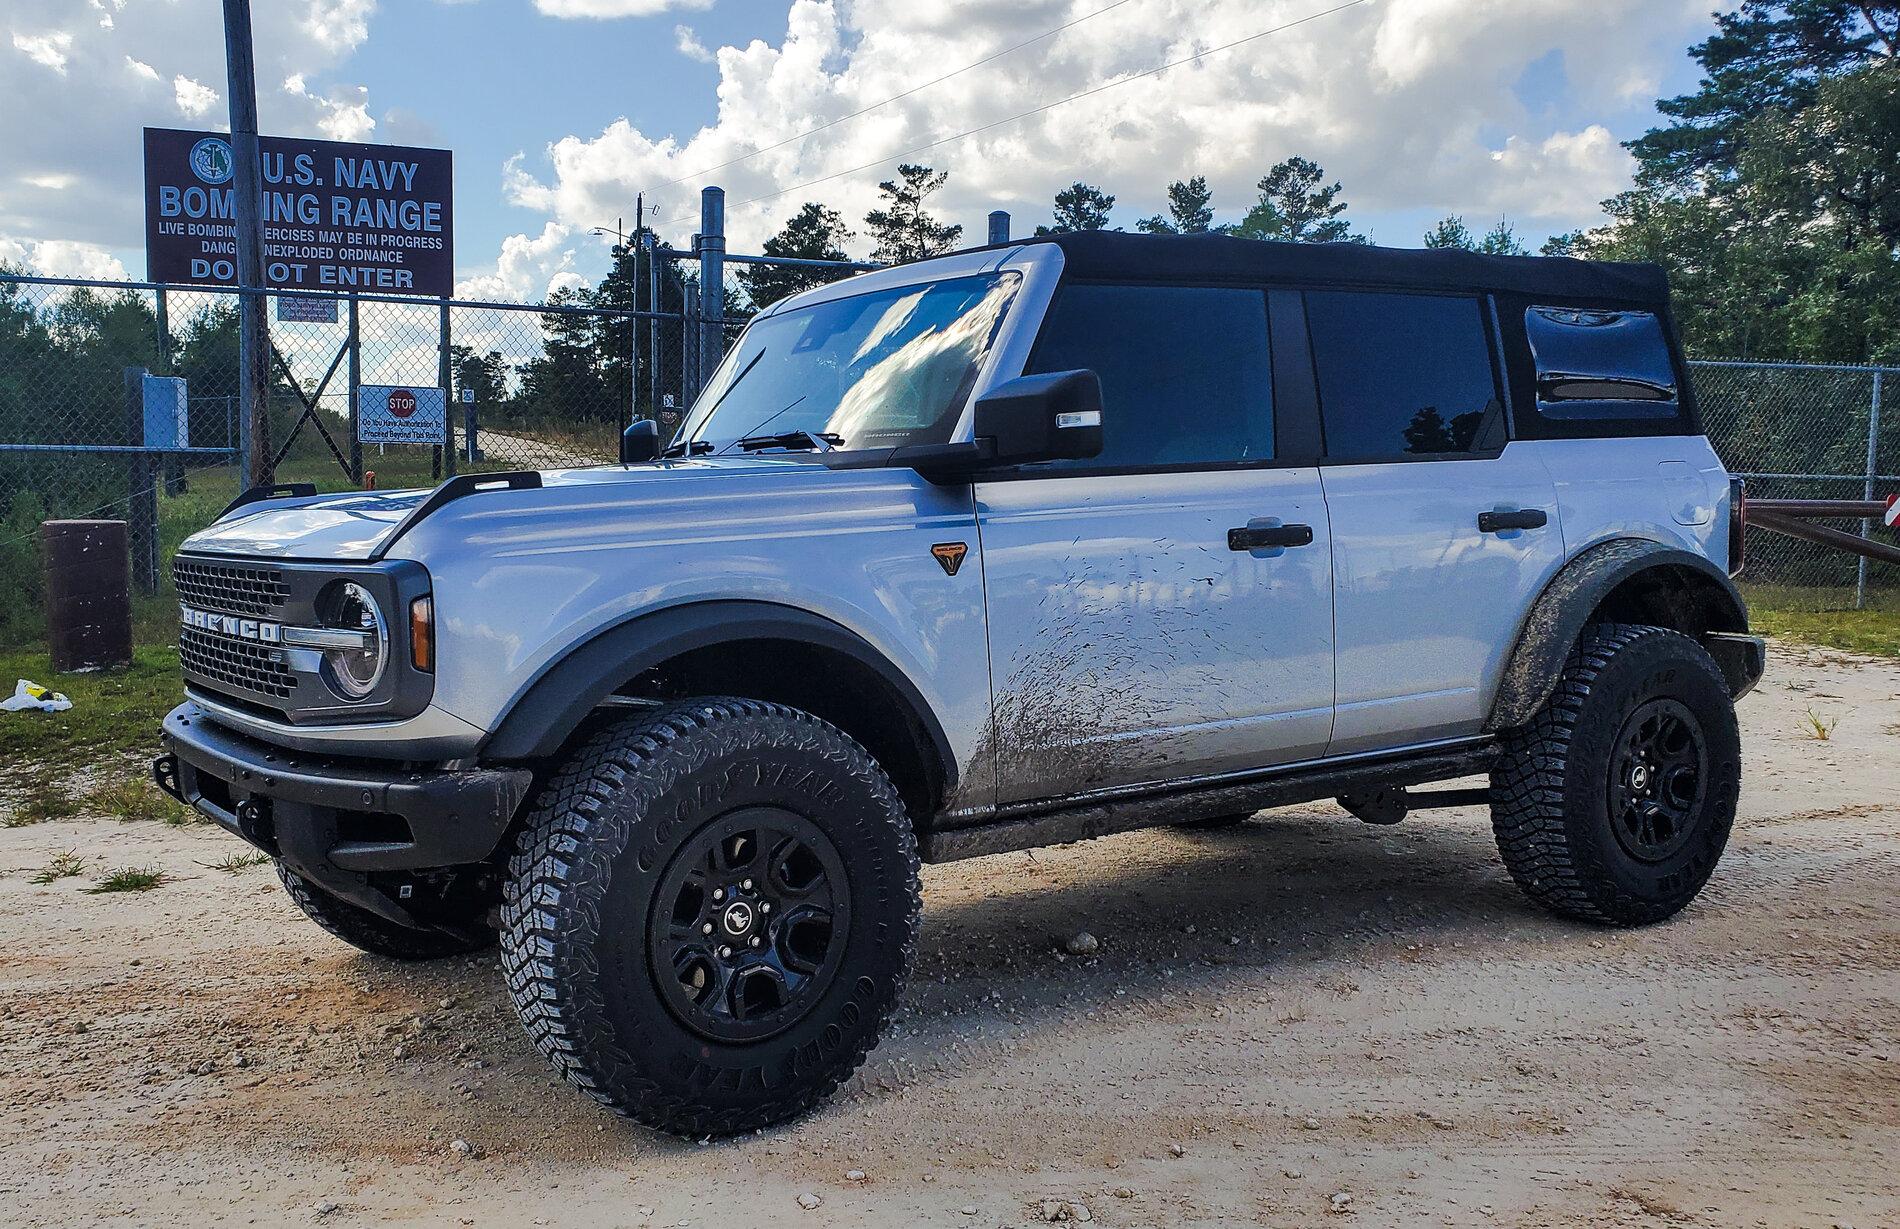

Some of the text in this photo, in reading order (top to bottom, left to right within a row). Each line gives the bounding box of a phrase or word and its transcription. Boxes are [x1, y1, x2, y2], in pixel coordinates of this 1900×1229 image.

[263, 152, 323, 186] U.S.
[334, 157, 419, 192] NAVY
[160, 185, 442, 232] BOMING RANGE
[158, 222, 443, 250] LIVE BOMBIN ERCISES MAY BE IN PROGRESS
[201, 240, 404, 263] DANG NEXPLODED ORDNANCE
[191, 258, 413, 289] DO OT ENTER
[389, 398, 415, 410] STOP
[182, 607, 281, 642] BRONCO
